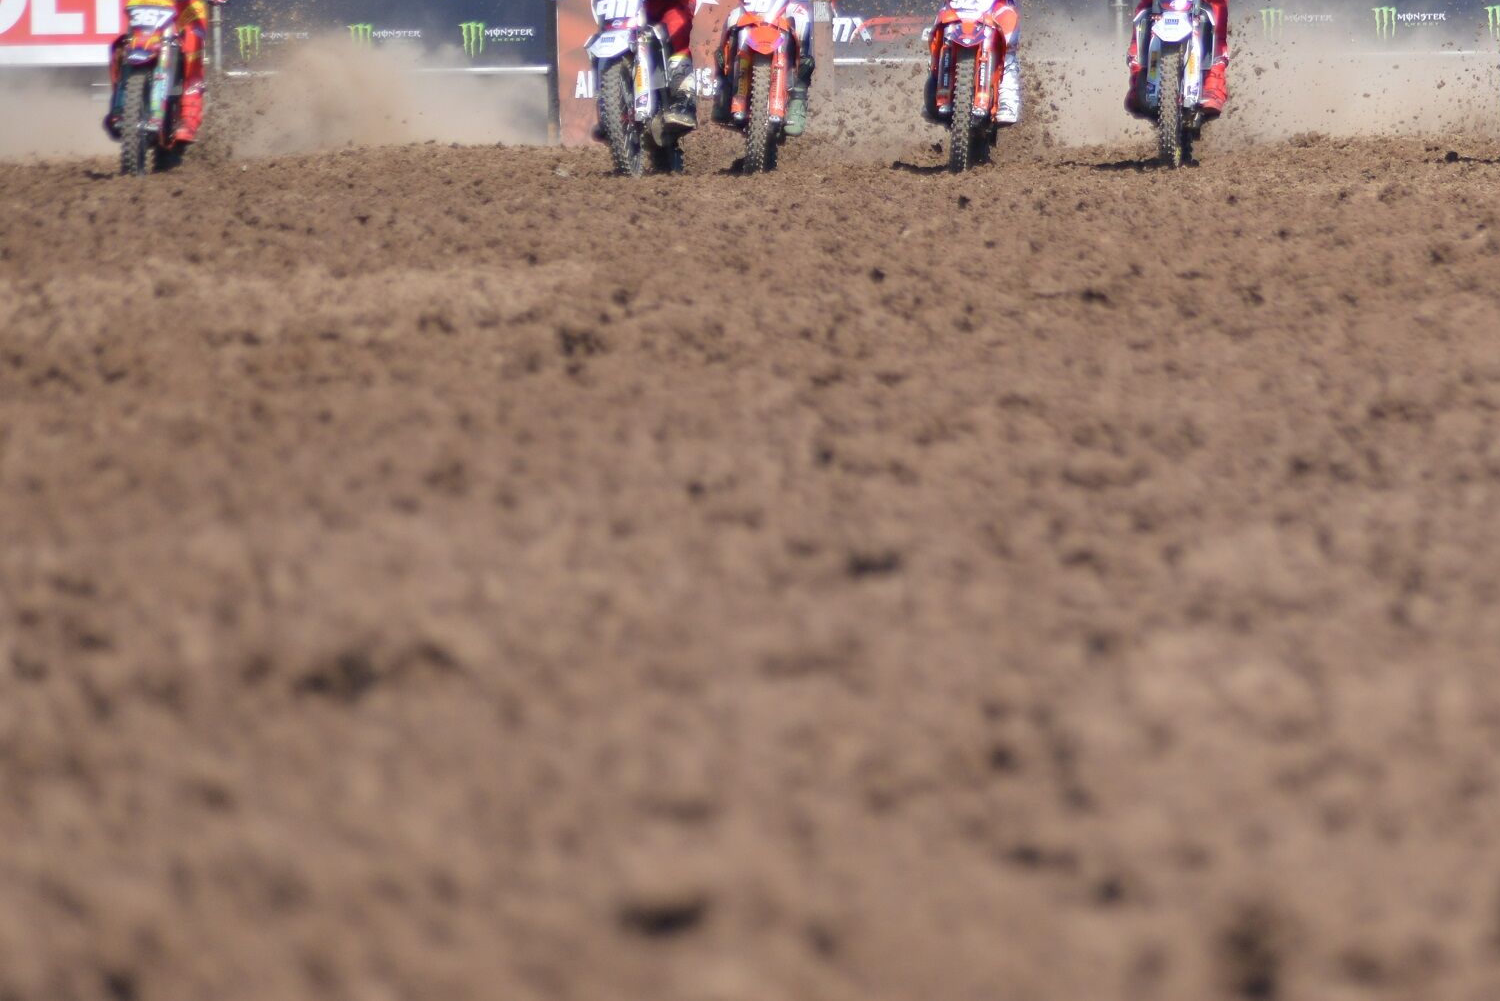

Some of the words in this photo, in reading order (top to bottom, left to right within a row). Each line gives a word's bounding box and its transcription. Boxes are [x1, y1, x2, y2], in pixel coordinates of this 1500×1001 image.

[1397, 12, 1447, 22] MONSTER
[372, 28, 421, 39] MONSTER
[485, 27, 533, 38] MONSTER
